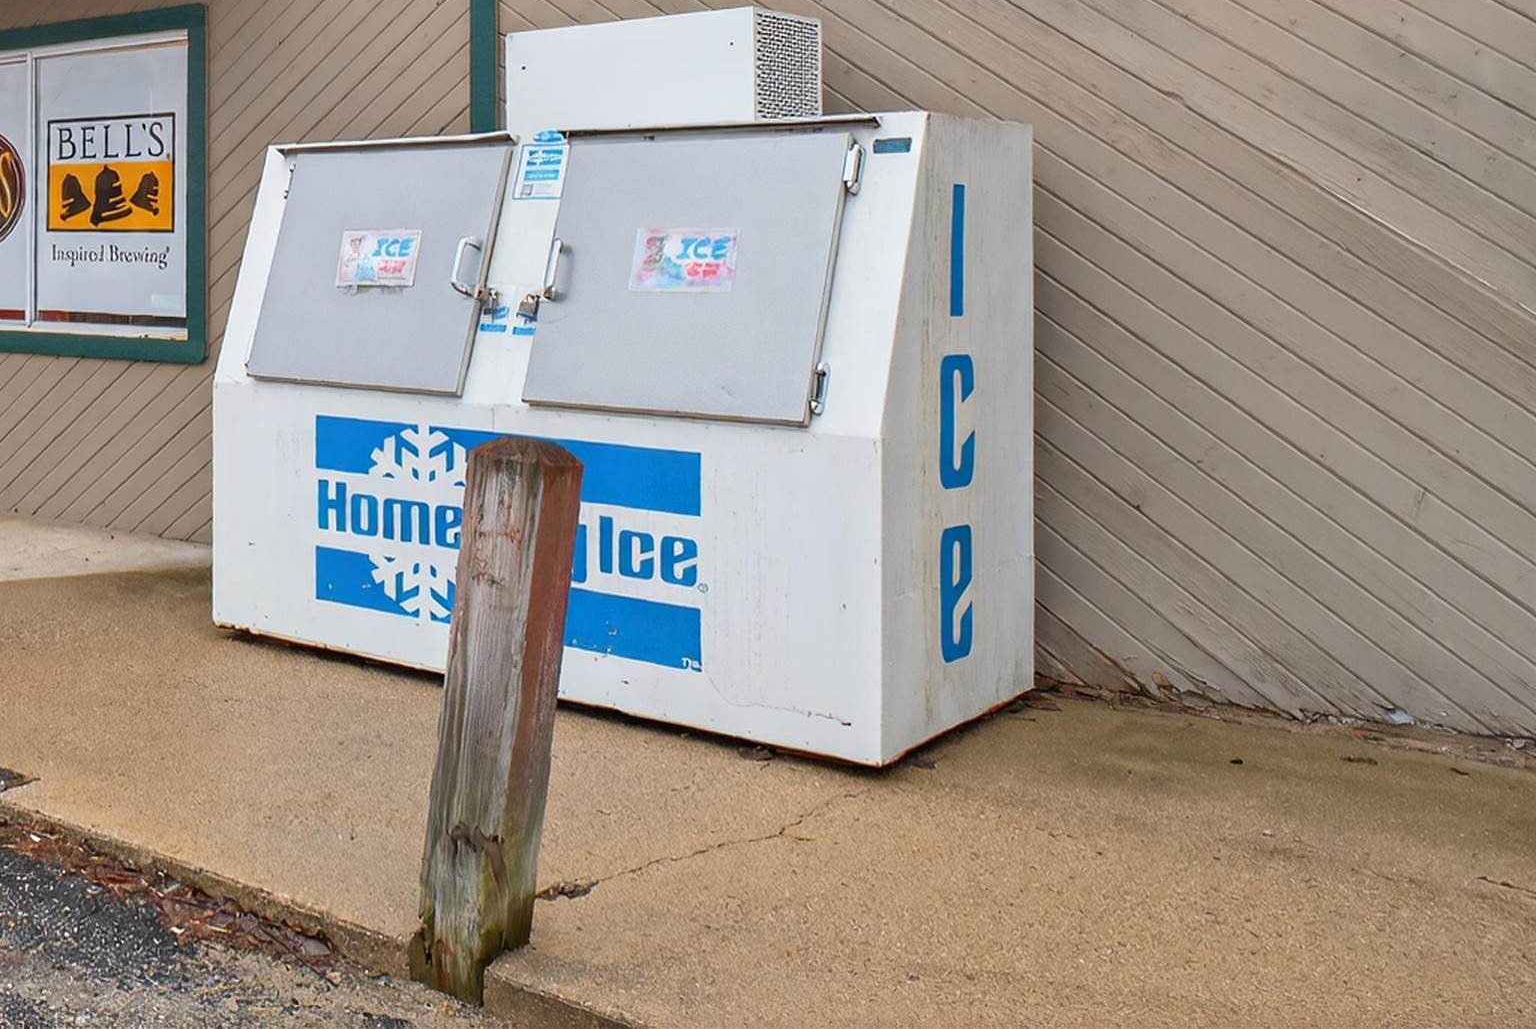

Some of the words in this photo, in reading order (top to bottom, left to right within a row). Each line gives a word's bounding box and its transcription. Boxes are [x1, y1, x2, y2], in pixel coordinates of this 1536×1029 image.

[57, 122, 165, 161] BELL'S
[109, 244, 168, 270] Brewing
[372, 236, 415, 257] ICE
[675, 235, 732, 260] ICE
[318, 479, 464, 551] Home
[599, 515, 698, 588] Ice
